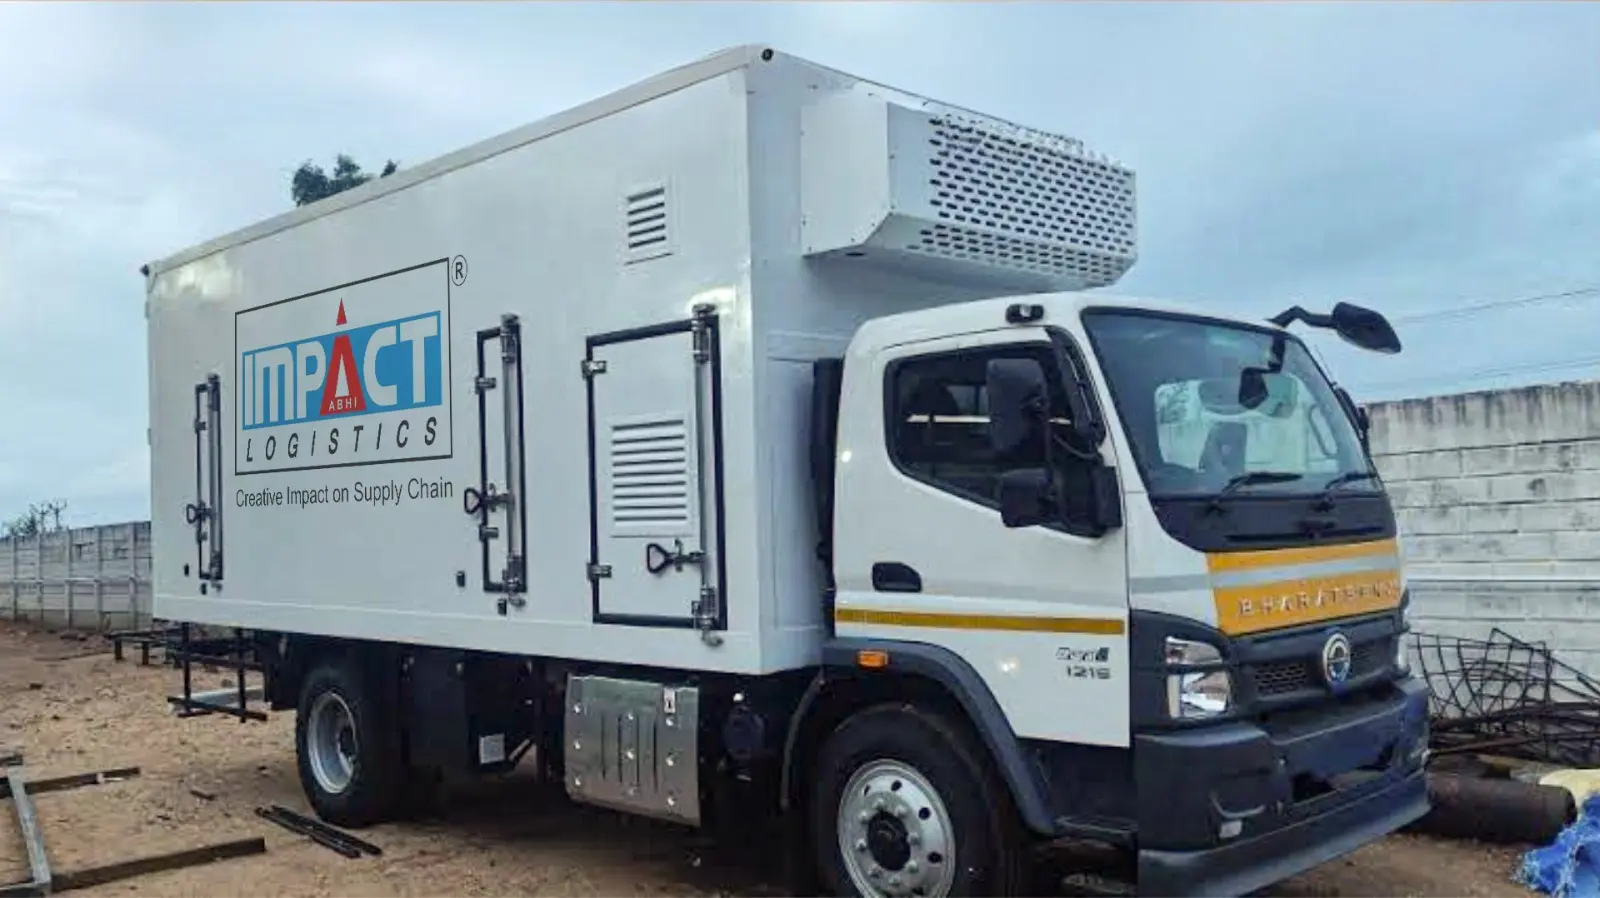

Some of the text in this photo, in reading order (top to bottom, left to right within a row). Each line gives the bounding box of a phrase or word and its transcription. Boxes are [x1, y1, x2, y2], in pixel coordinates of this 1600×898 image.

[244, 314, 439, 427] IMPACT
[328, 396, 357, 412] ABHI
[246, 416, 437, 462] LOGISTICS
[236, 476, 453, 509] Creative Impact on Supply Chain
